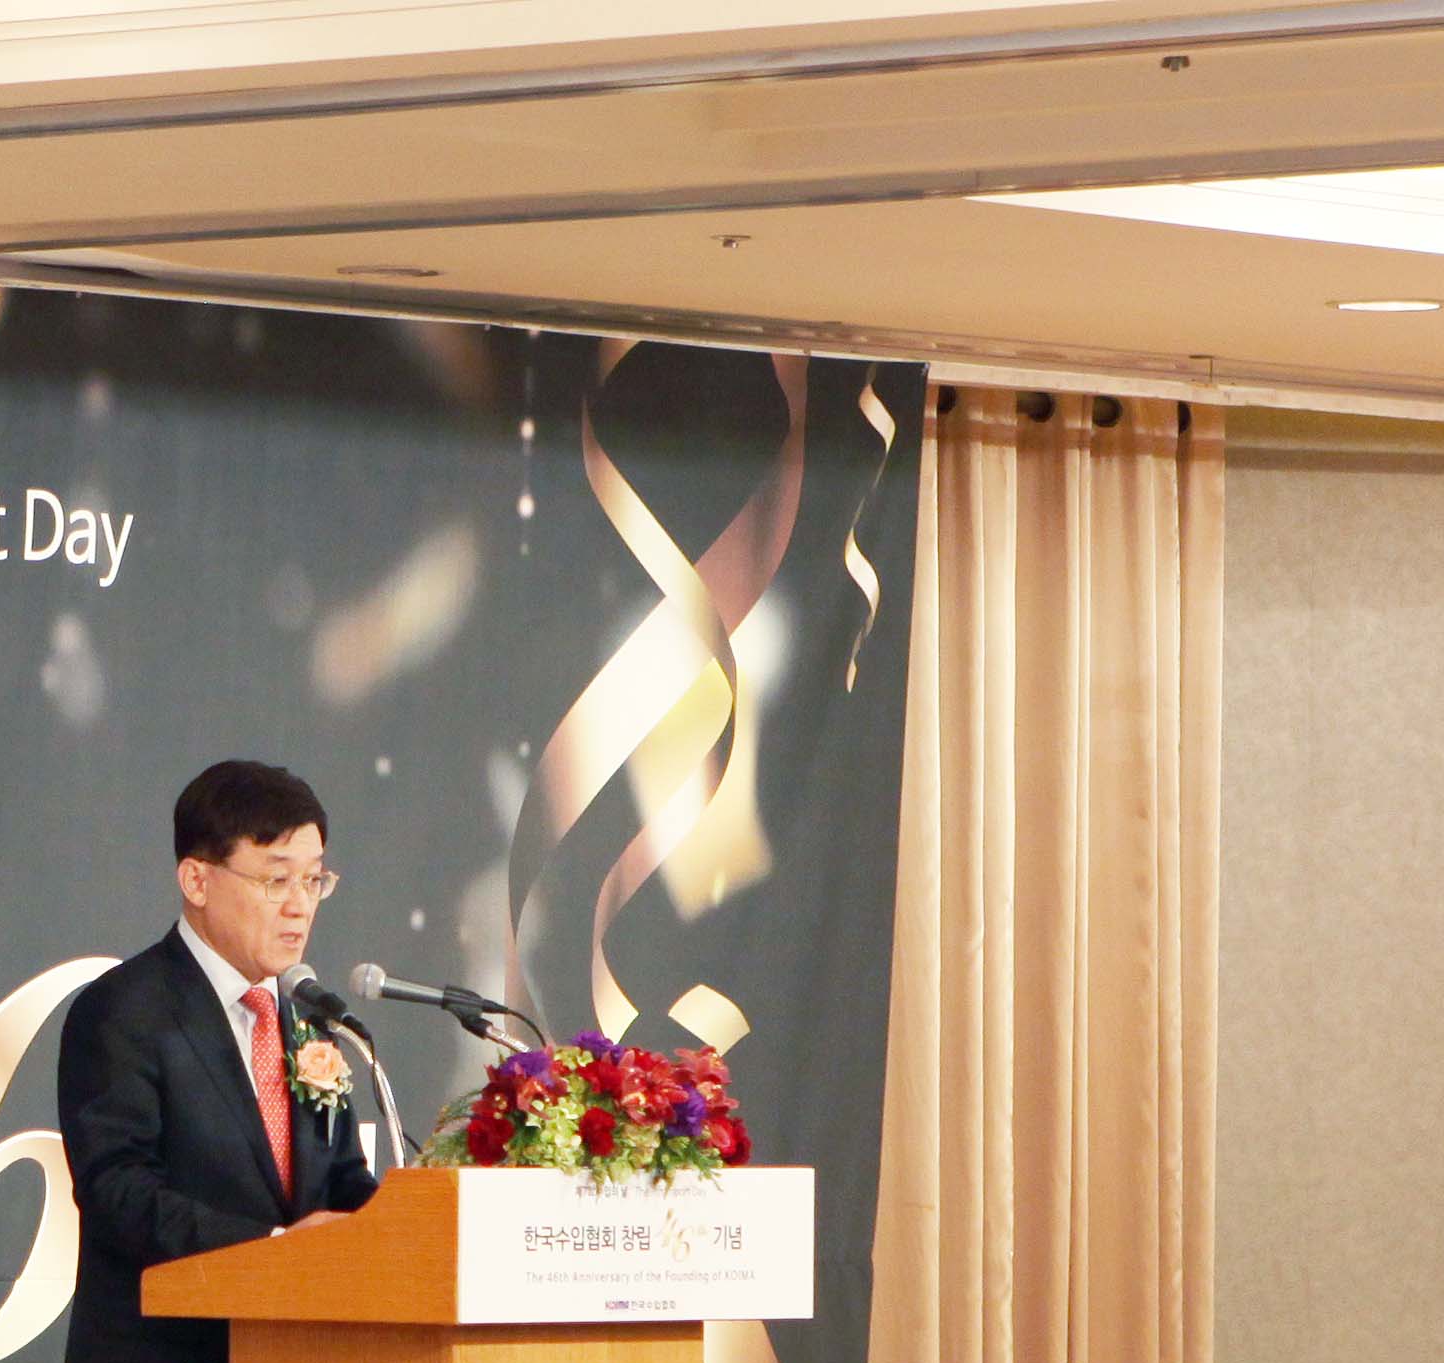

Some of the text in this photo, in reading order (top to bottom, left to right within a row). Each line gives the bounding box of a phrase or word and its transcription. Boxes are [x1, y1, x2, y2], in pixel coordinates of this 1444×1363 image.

[23, 488, 134, 588] Day
[524, 1225, 617, 1252] 한국수입협회
[621, 1225, 651, 1252] 창립
[713, 1224, 743, 1251] 기념
[525, 1271, 543, 1284] The
[573, 1270, 629, 1286] Anniversary
[633, 1270, 644, 1283] of
[646, 1270, 662, 1283] the
[665, 1270, 709, 1285] Founding
[711, 1270, 722, 1283] of
